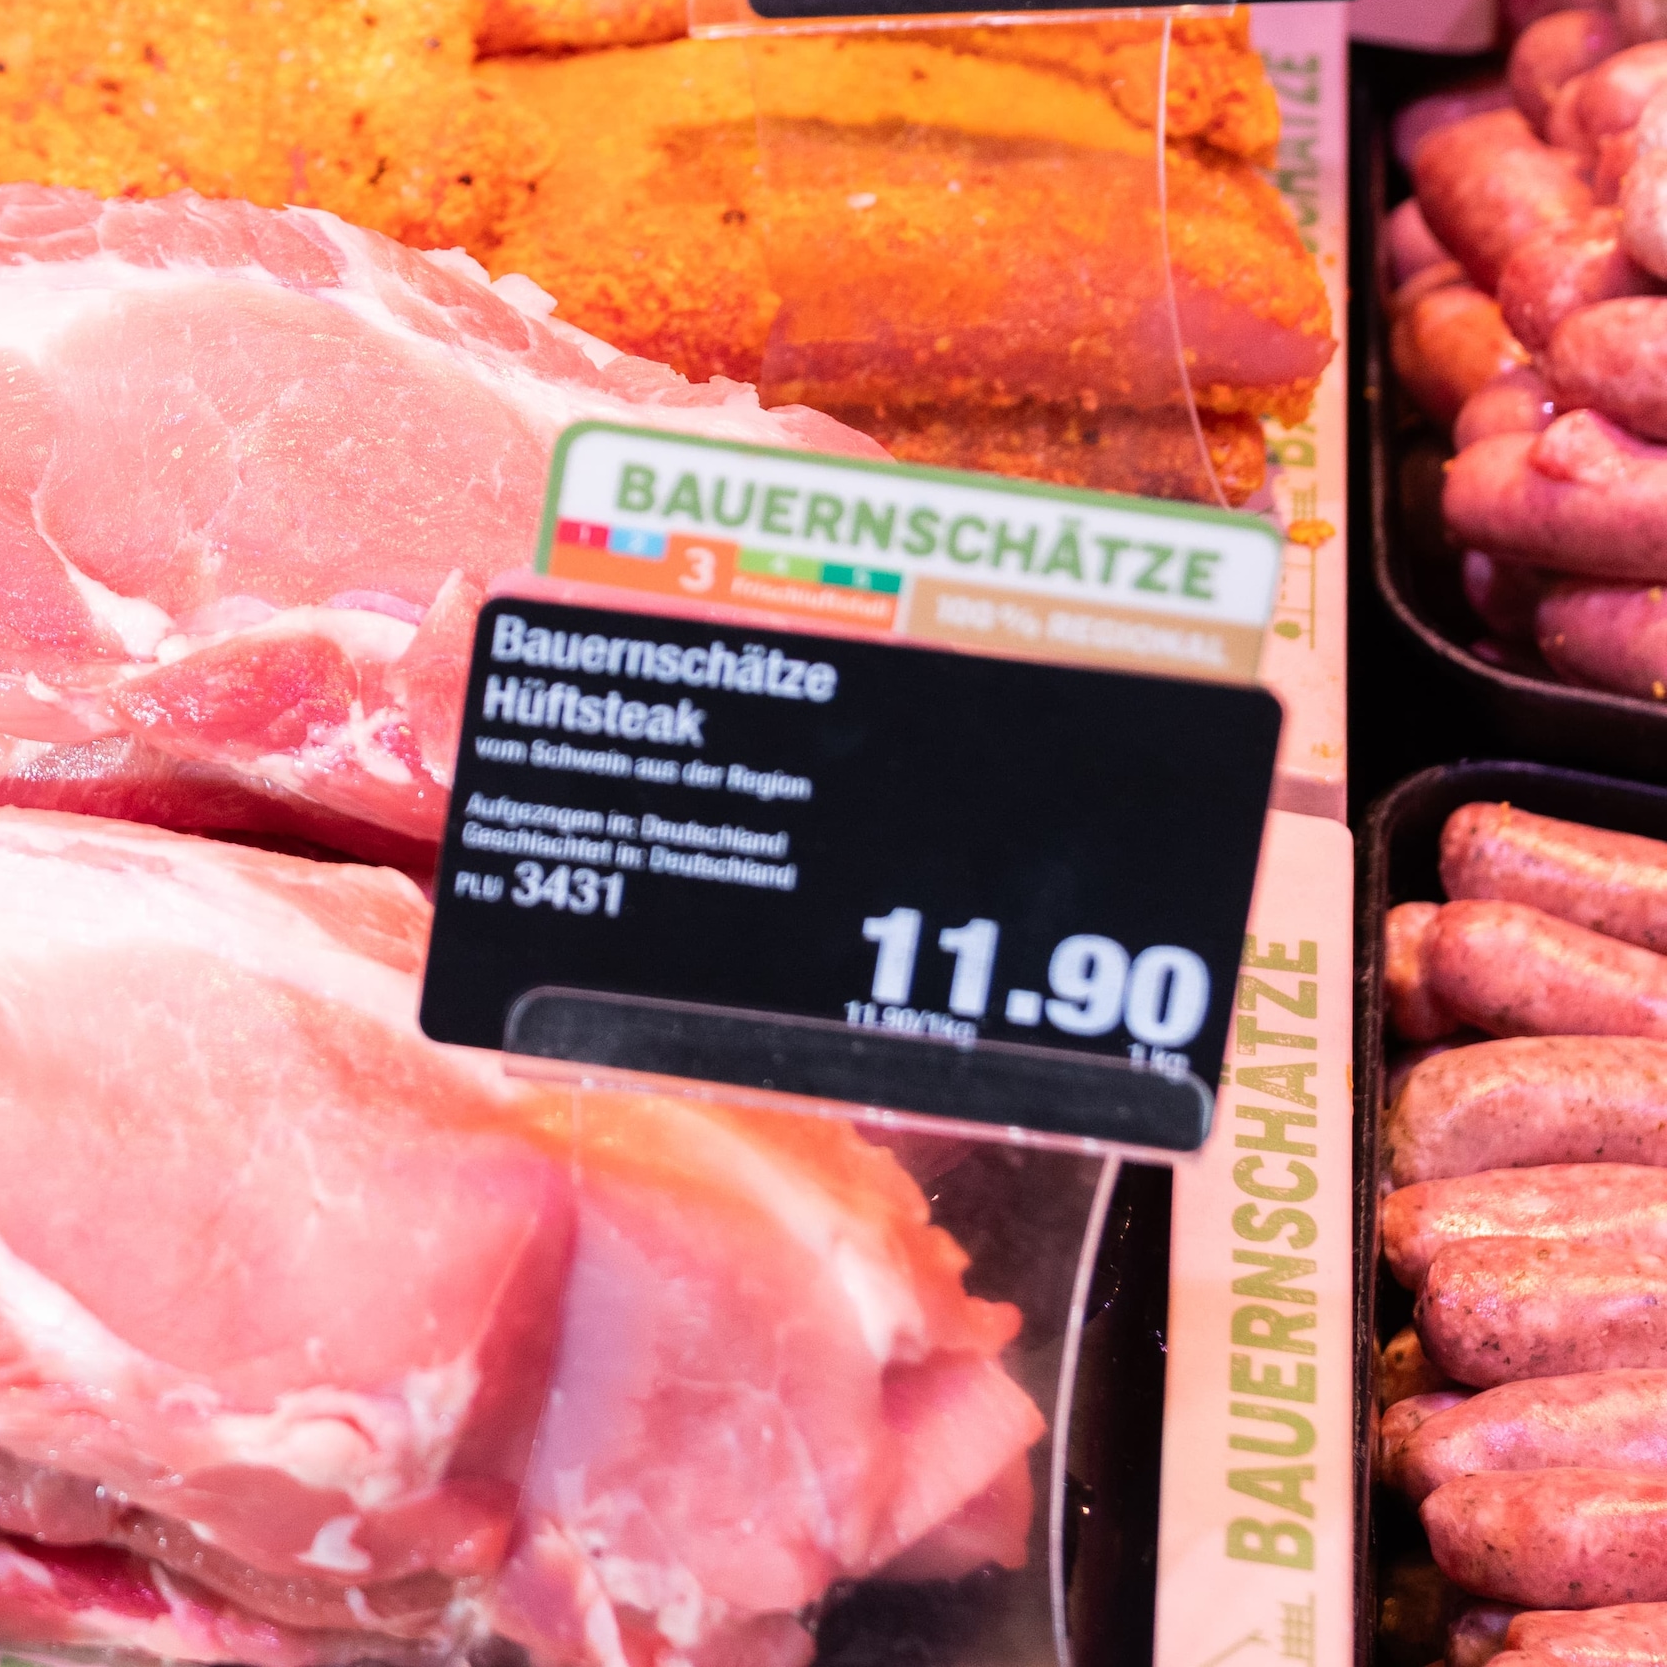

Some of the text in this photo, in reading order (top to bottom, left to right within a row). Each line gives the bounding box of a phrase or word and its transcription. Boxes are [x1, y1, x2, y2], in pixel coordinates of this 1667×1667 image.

[617, 462, 1223, 601] BAUERNSCHÄTZE
[677, 546, 717, 593] 3
[491, 613, 838, 703] Bauernschätze
[482, 674, 707, 748] Hüftsteak
[475, 736, 813, 802] vom Schwein aus der Region
[462, 821, 613, 865] Geschlachtet
[648, 844, 798, 891] Deutschland
[464, 792, 605, 833] Aufgezogen
[640, 814, 789, 859] Deutschland
[454, 860, 625, 918] PLU 3431
[862, 906, 1211, 1048] 11.90
[1219, 933, 1318, 1572] BAUERNSCHÄTZE
